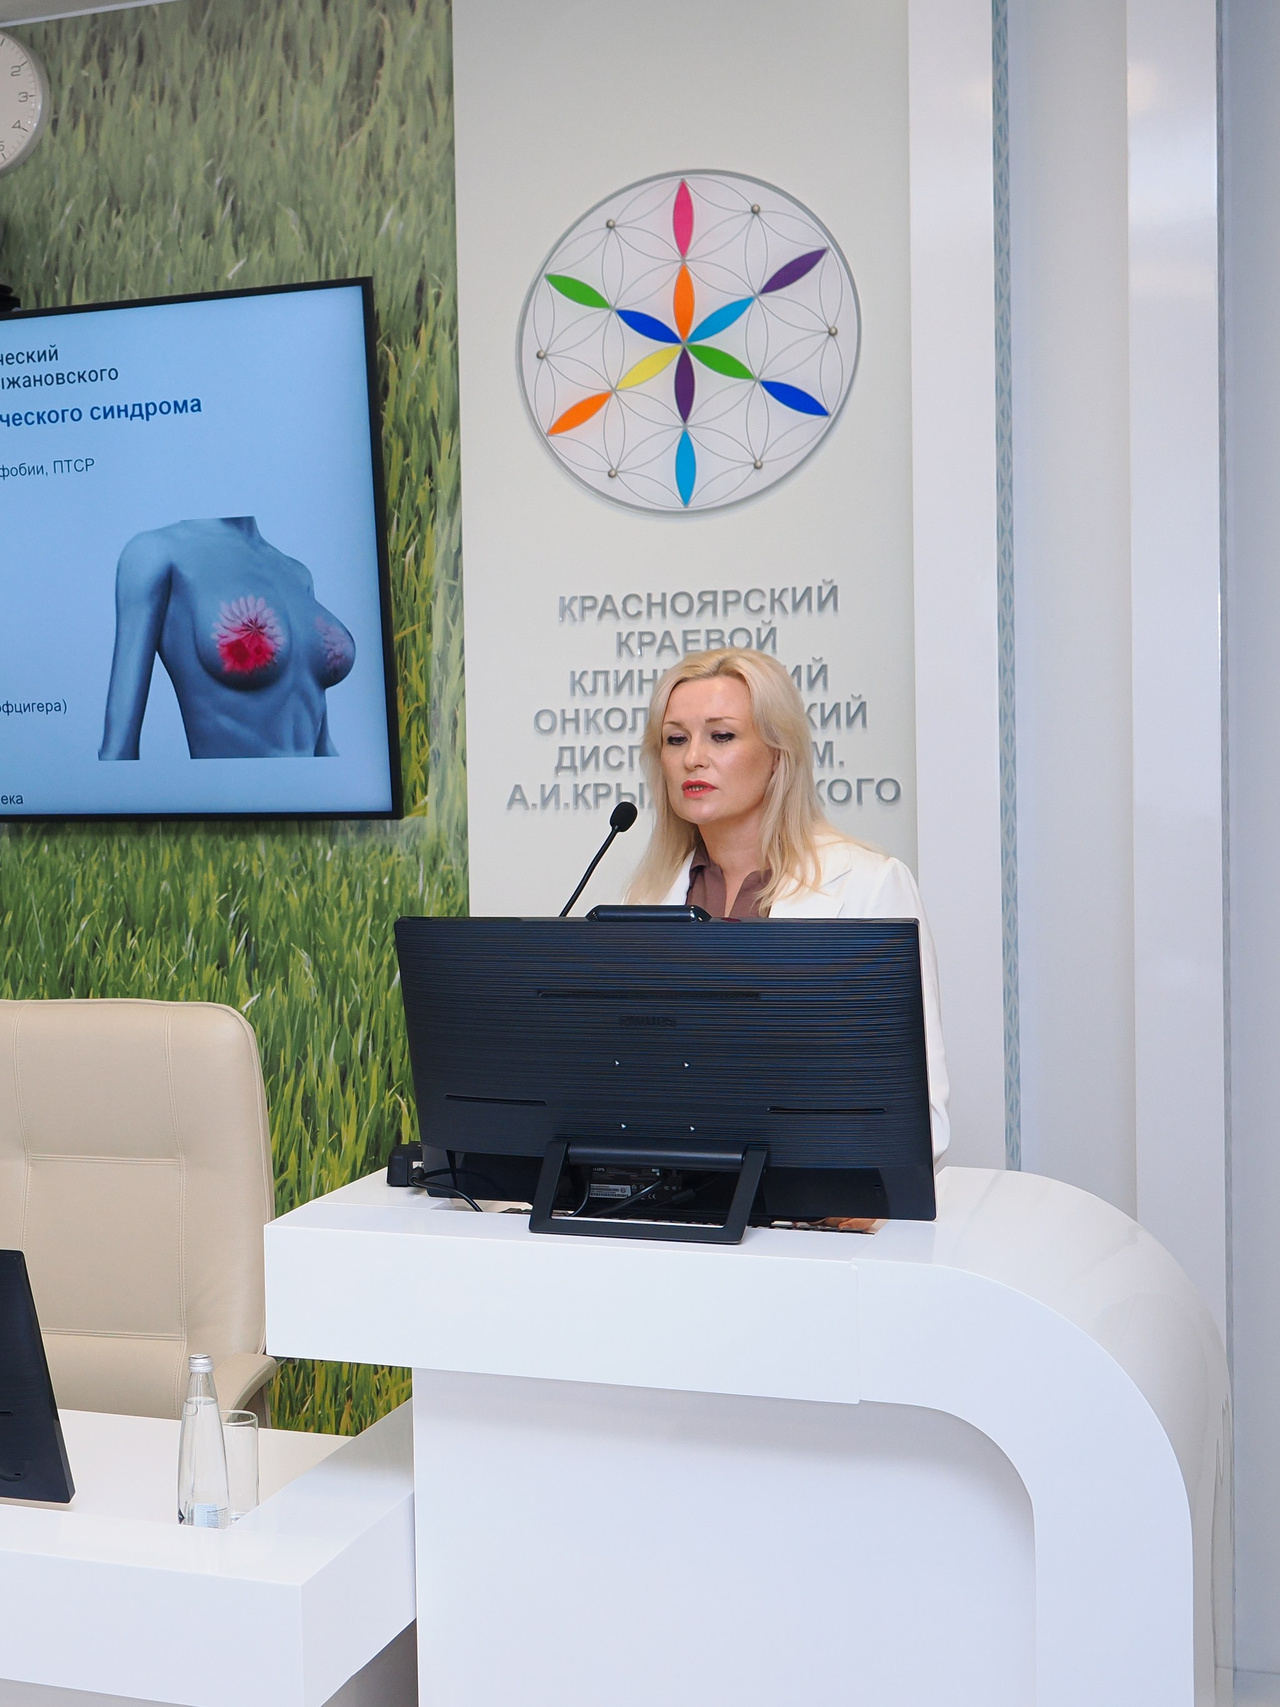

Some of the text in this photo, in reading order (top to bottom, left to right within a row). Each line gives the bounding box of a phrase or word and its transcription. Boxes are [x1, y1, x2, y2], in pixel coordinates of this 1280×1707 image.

[10, 66, 21, 77] 2
[18, 91, 29, 102] 3
[11, 120, 22, 131] 4
[90, 398, 202, 422] синдрома
[53, 458, 95, 474] ПТСР
[558, 579, 839, 622] КРАСНОЯРСКИЙ
[616, 619, 777, 657] КРАЕВОЙ
[570, 656, 828, 696] КЛИНИЙ
[533, 693, 867, 735] ОНКОЛКИЙ
